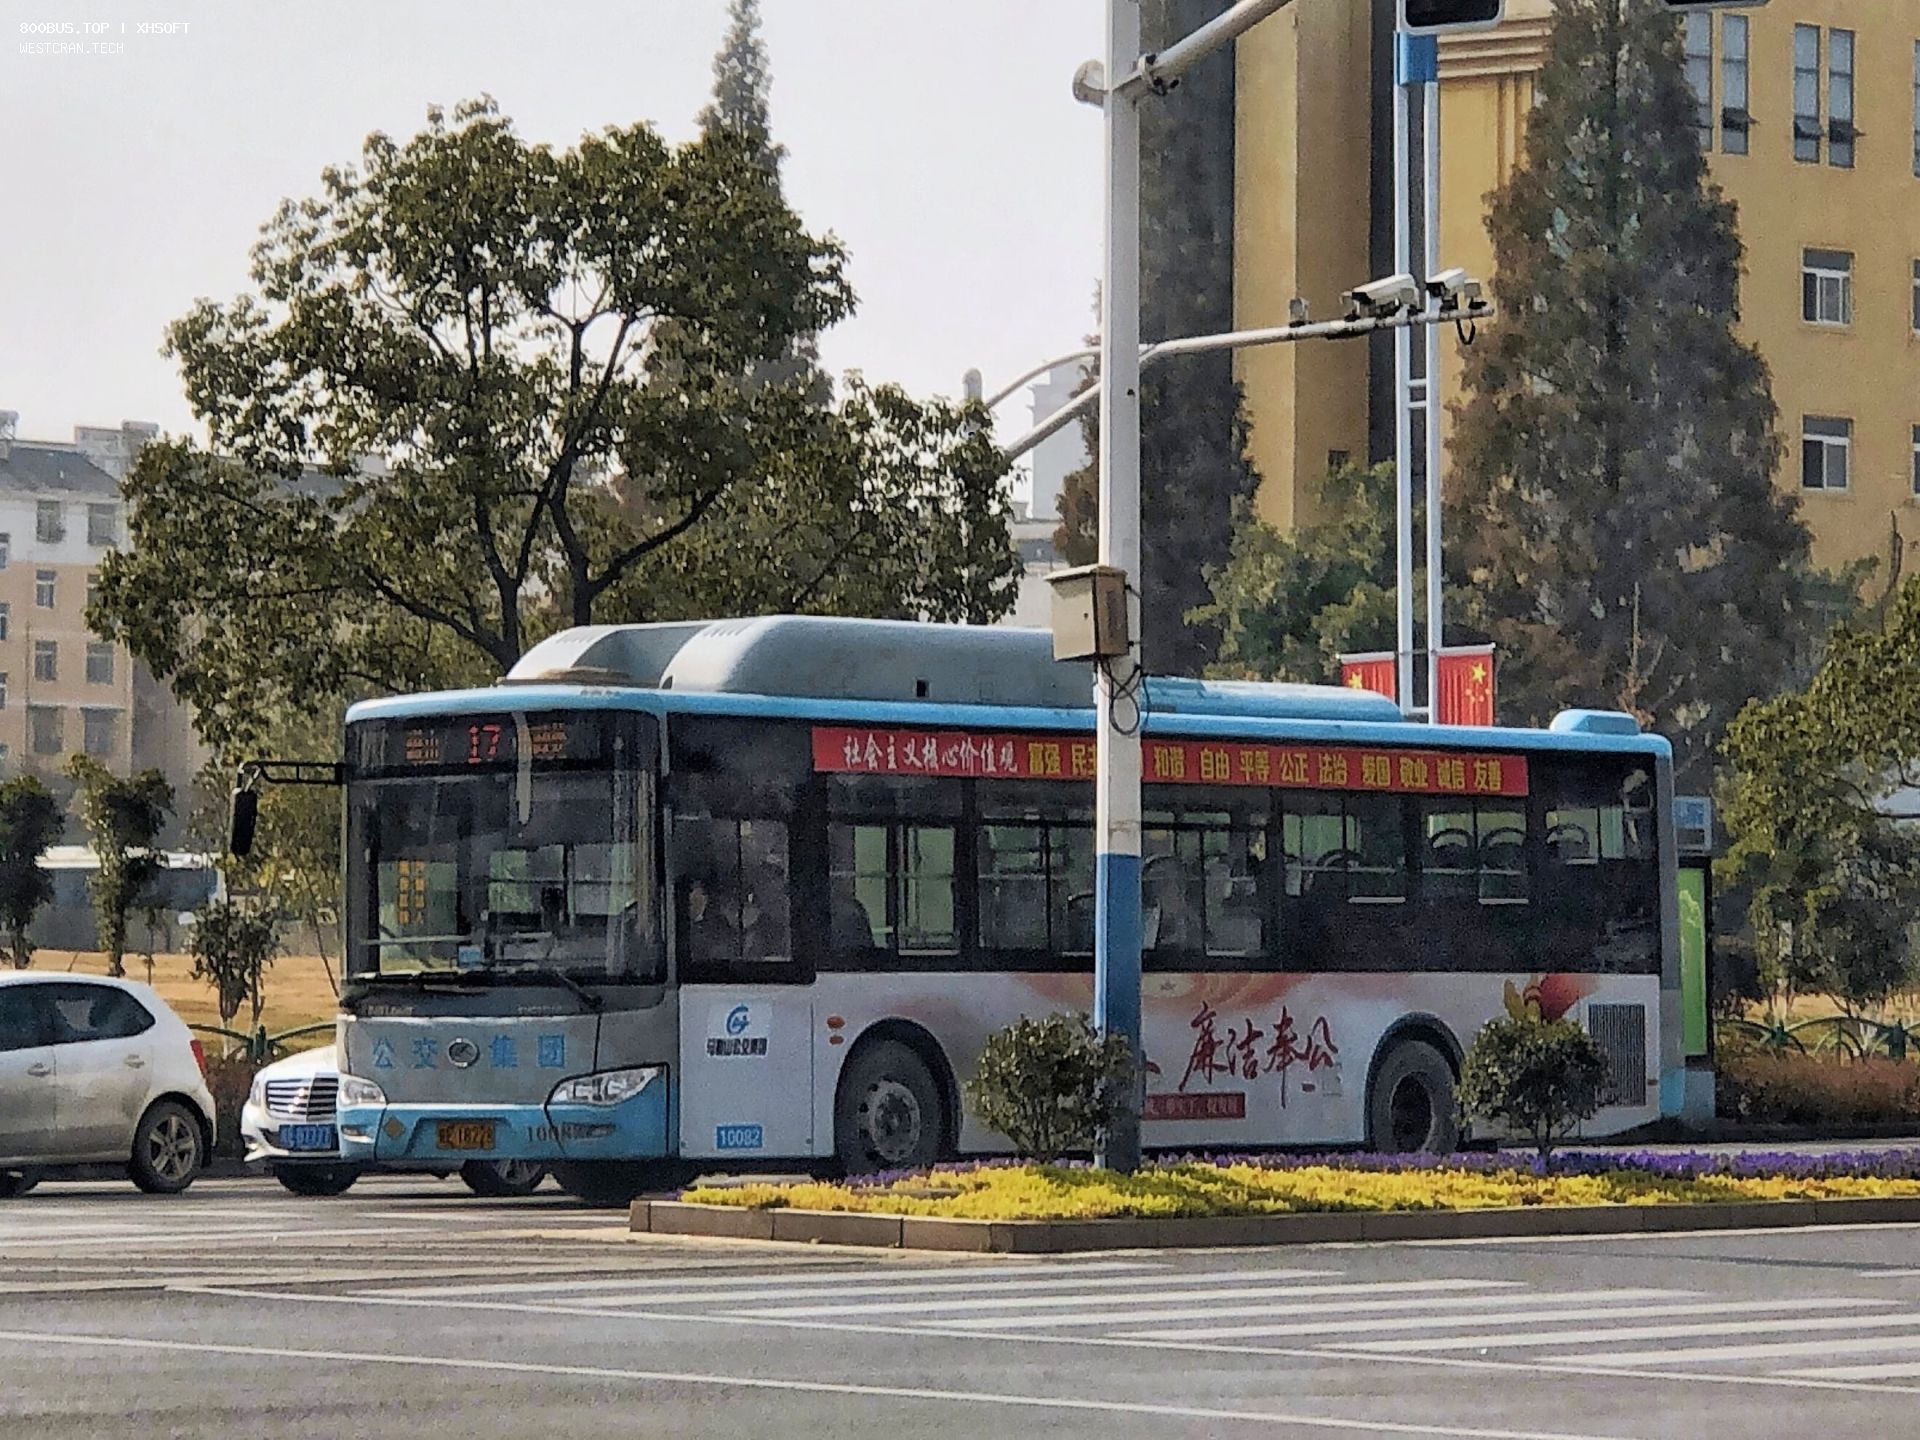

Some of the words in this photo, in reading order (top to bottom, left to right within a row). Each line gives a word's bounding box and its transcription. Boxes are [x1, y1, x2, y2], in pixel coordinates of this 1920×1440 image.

[468, 724, 500, 764] 17
[843, 733, 1018, 773] 社会主义核心价值观
[1028, 743, 1060, 775] 富强
[1154, 746, 1184, 778] 和谐
[1200, 748, 1230, 779] 自由
[1240, 750, 1270, 782] 平等
[1279, 752, 1309, 783] 公正
[1319, 753, 1347, 785] 法治
[1362, 754, 1391, 786] 爱国
[1400, 756, 1428, 787] 敬业
[1437, 758, 1465, 789] 诚信
[1474, 759, 1502, 791] 友善
[373, 1034, 566, 1069] 公交集团
[1179, 1000, 1339, 1109] 廉洁奉公
